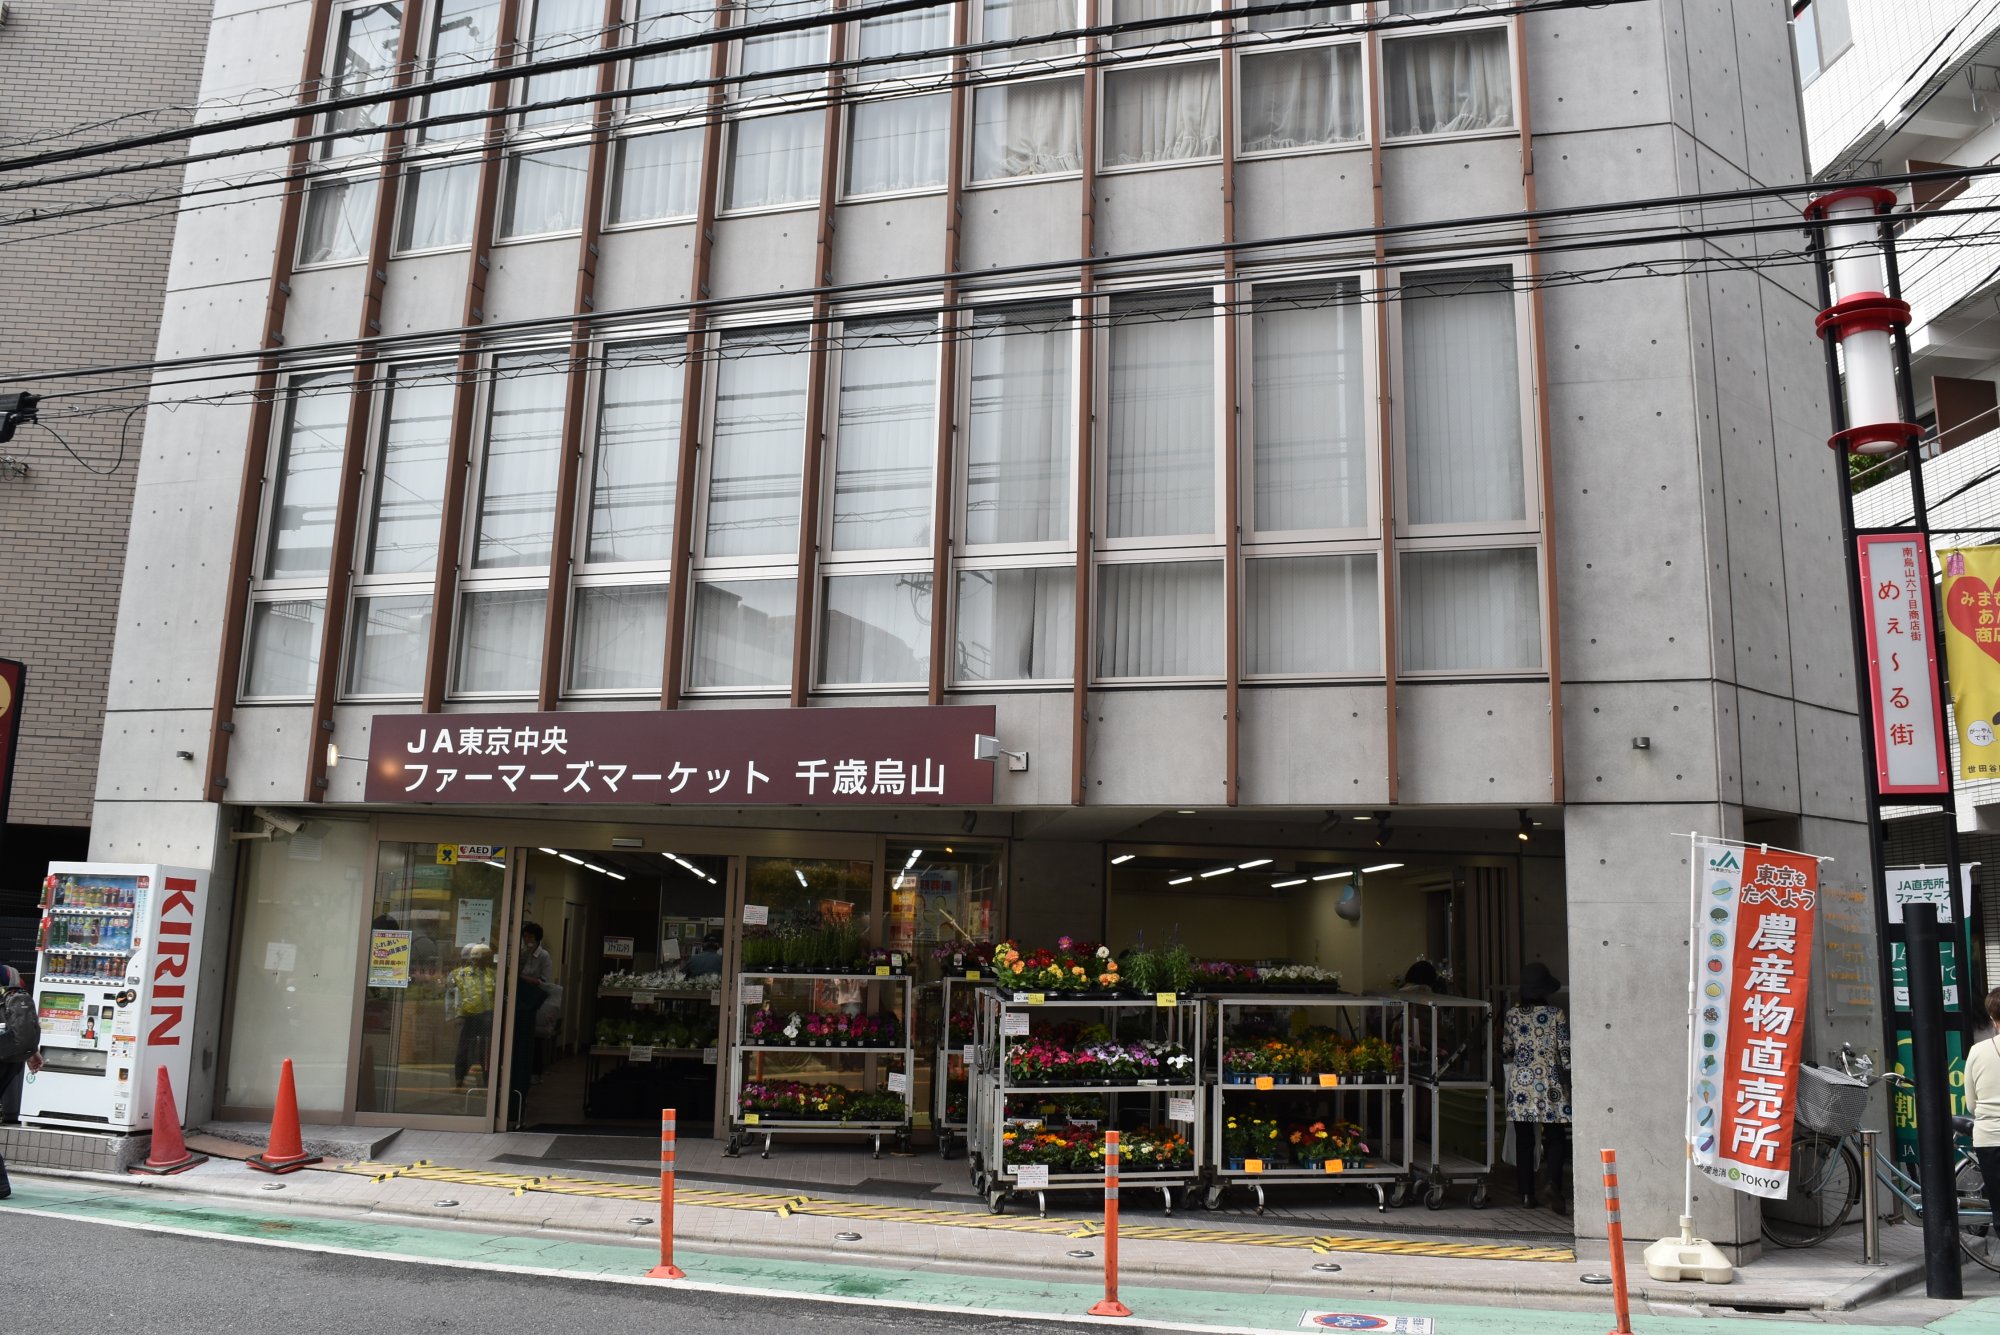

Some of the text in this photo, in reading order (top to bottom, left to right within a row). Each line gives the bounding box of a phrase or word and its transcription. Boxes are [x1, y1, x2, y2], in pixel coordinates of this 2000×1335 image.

[1979, 609, 2000, 625] あ
[407, 726, 568, 756] JA東京中央
[404, 758, 945, 795] ファーマーズマーケット 千歳烏山
[1967, 764, 2000, 774] 世田谷
[469, 846, 489, 854] AED
[1755, 864, 1806, 886] 東京を
[1741, 884, 1816, 911] たべよう
[148, 877, 196, 1046] KIRIN
[1732, 913, 1797, 1162] 農産物直売所
[1741, 1172, 1780, 1189] TOKYO
